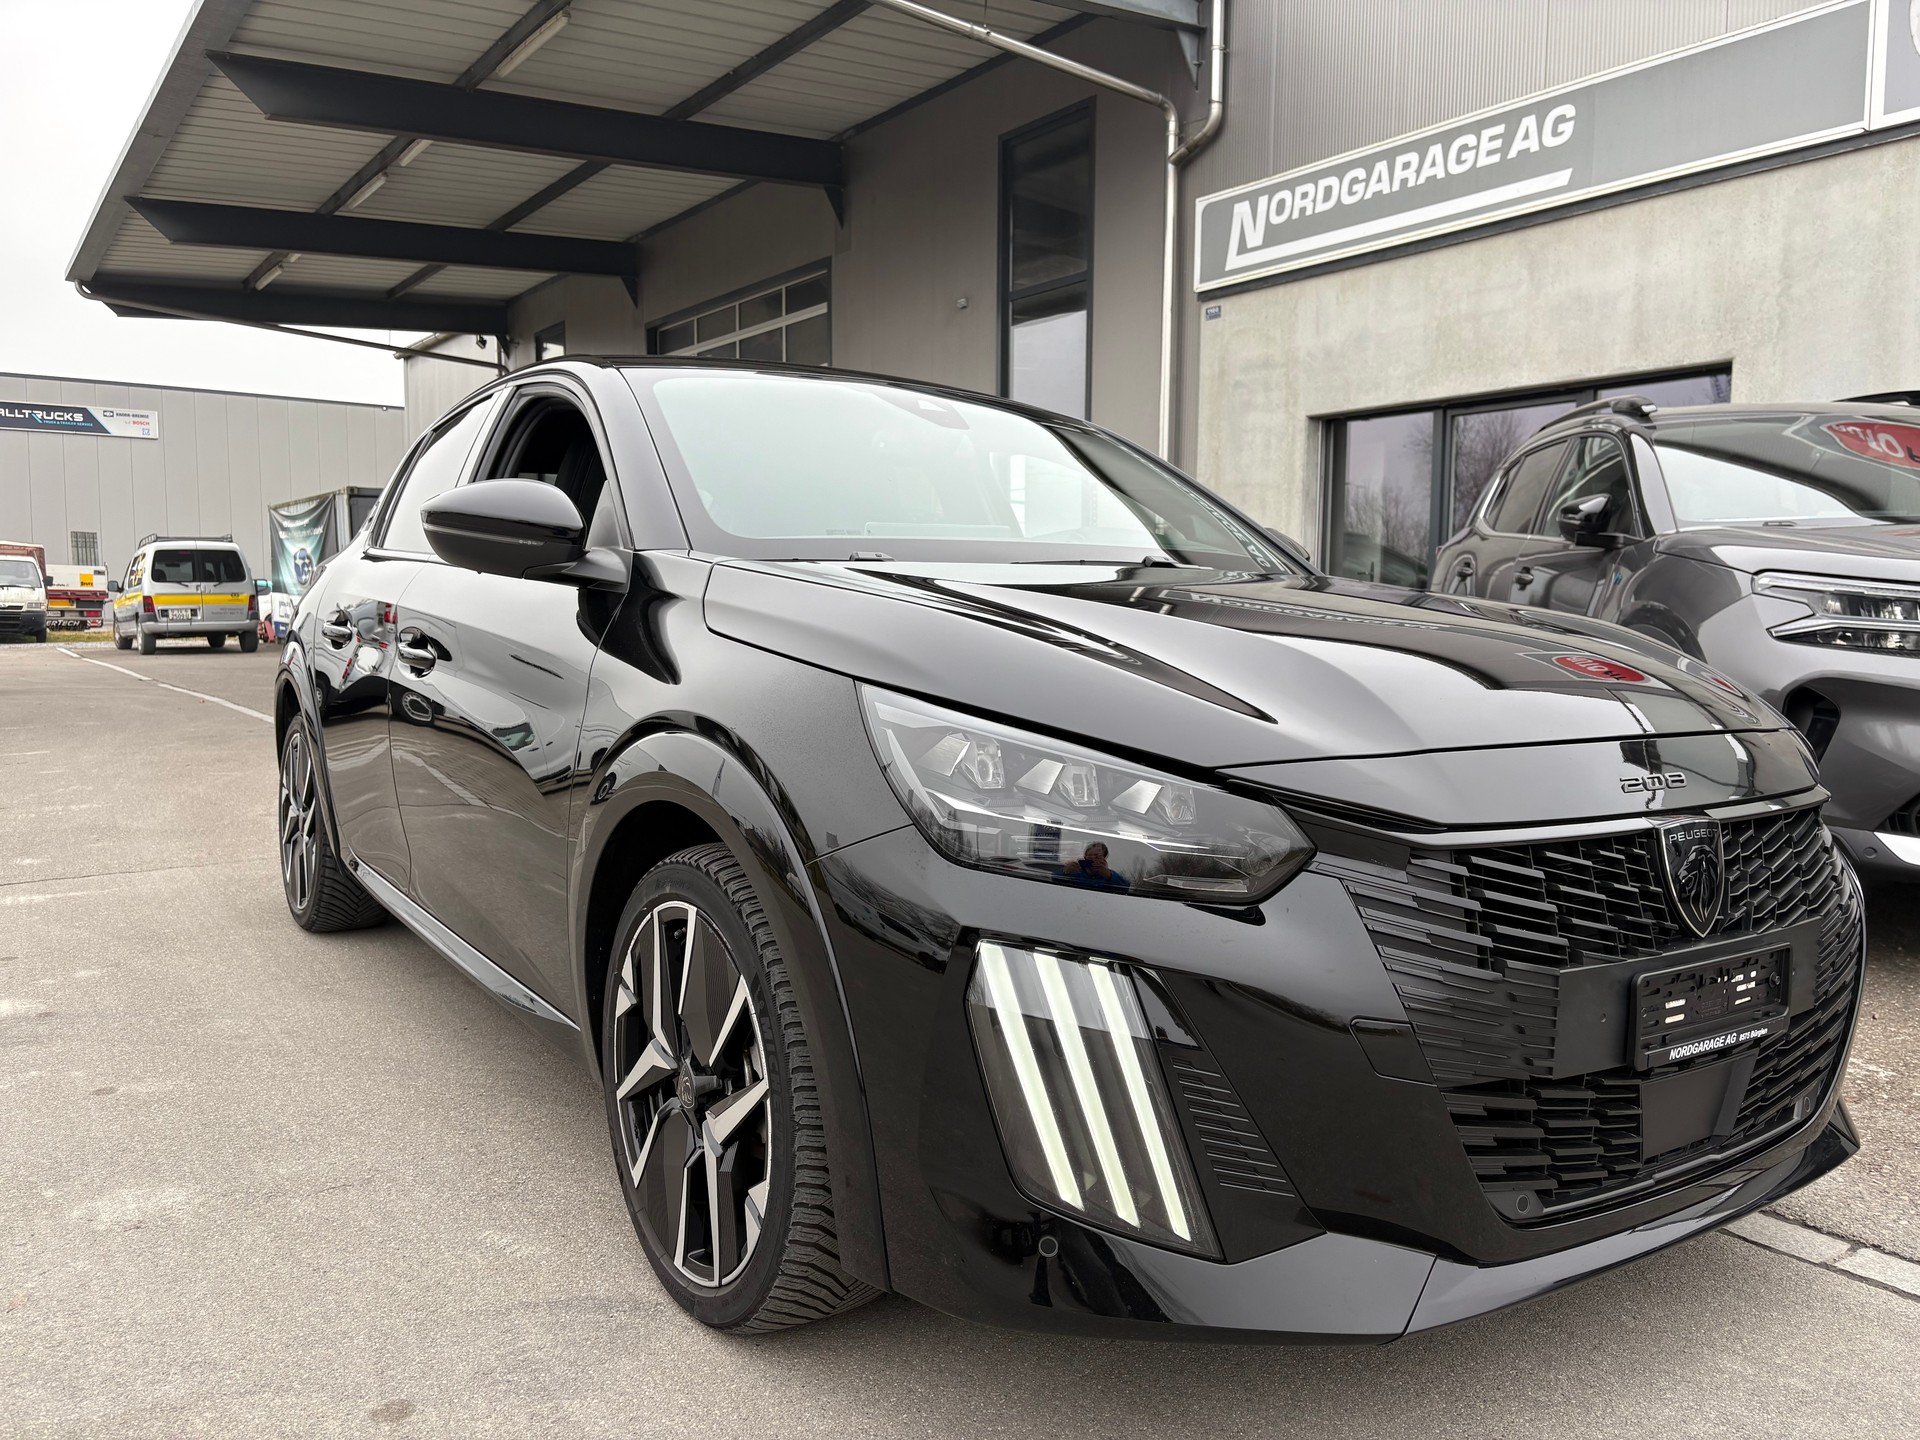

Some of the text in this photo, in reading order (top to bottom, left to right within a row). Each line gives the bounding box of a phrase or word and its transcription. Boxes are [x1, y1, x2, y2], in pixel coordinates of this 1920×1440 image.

[1224, 103, 1577, 271] NORDGARAGE AG
[1619, 772, 1687, 793] 208
[1669, 828, 1718, 844] PEUGEOT
[1669, 1035, 1726, 1060] NORDGARAGE
[1724, 1032, 1737, 1046] AG
